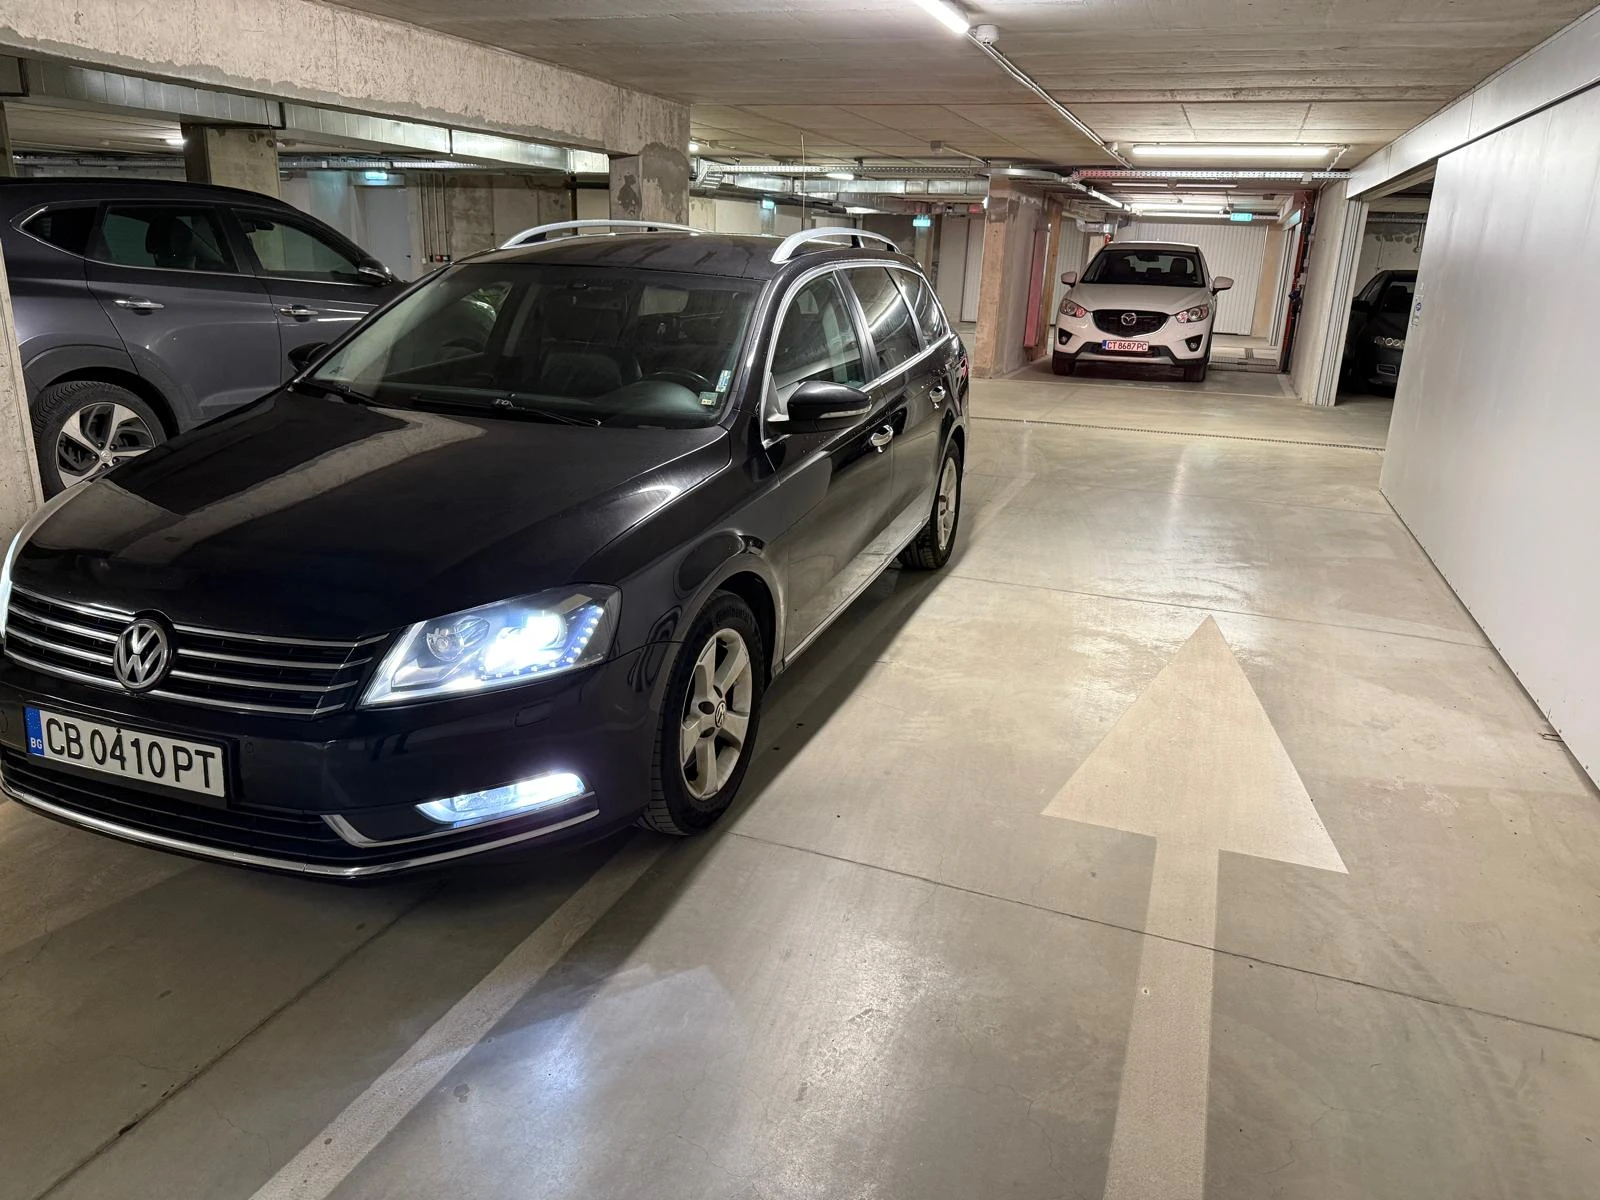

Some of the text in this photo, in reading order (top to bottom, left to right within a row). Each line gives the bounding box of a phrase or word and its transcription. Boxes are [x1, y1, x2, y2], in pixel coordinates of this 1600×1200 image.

[1107, 341, 1147, 350] CT 8687 PC
[31, 737, 43, 750] BG
[46, 718, 215, 789] CB 0410 PT
